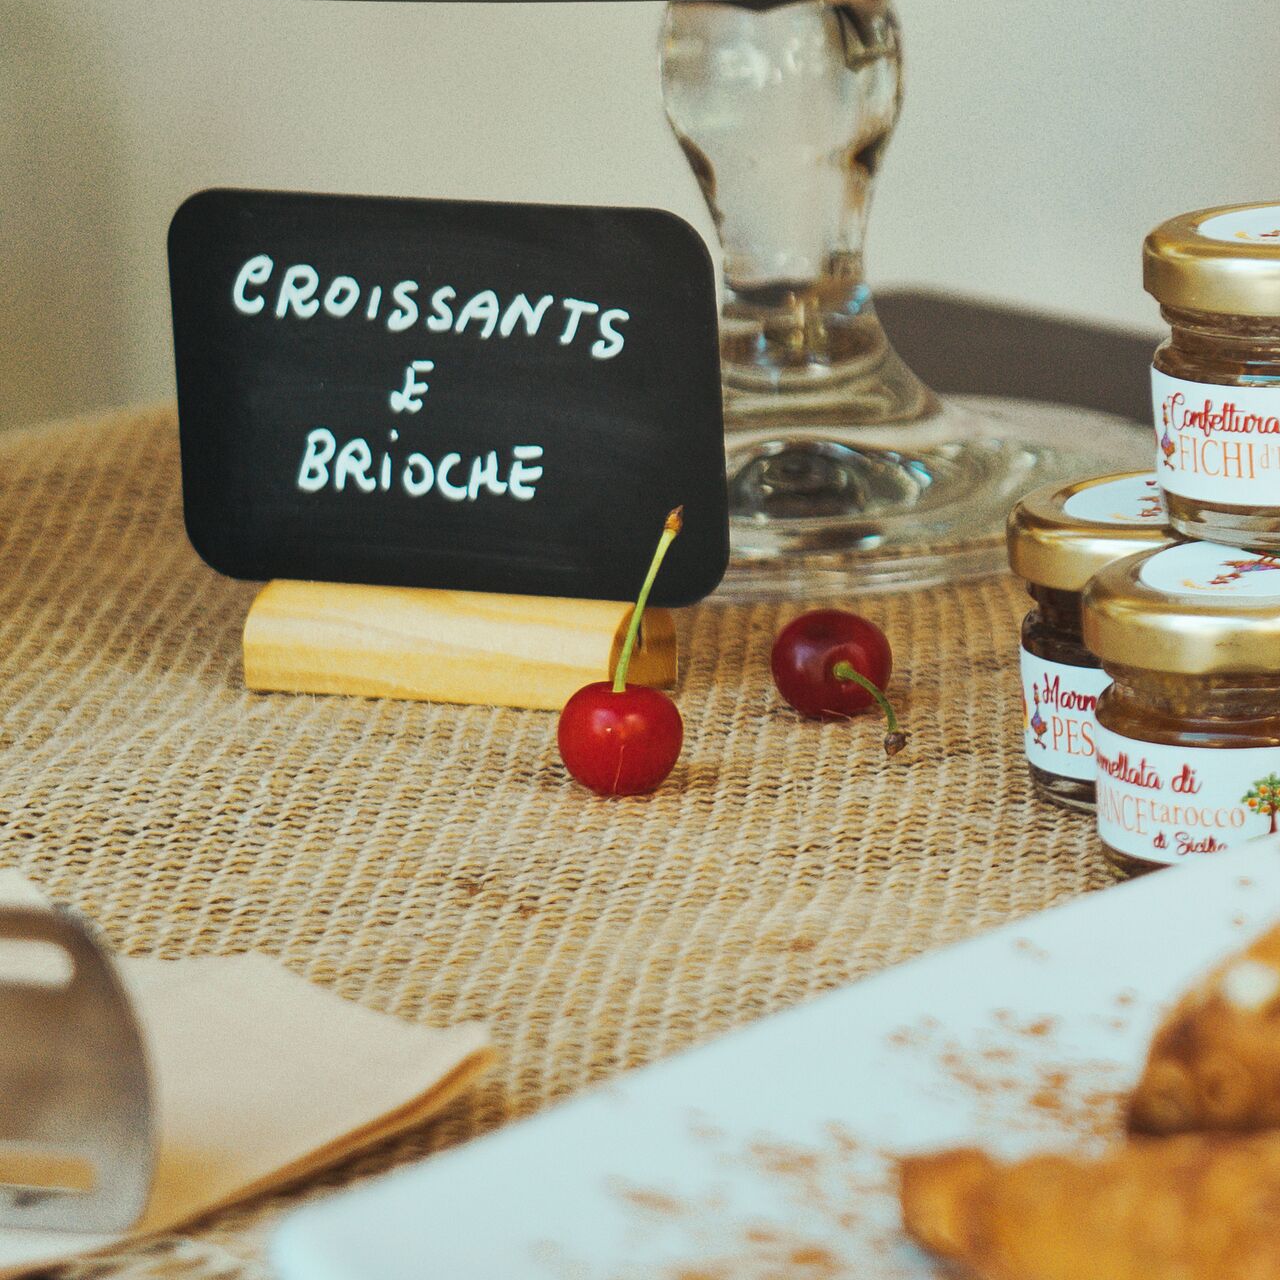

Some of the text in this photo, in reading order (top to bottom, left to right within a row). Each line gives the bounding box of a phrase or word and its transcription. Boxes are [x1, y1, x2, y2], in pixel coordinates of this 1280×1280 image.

[232, 254, 630, 359] CROISSANTS
[1179, 434, 1256, 479] FICHI
[1052, 716, 1095, 756] PES
[1171, 763, 1202, 794] di
[1151, 799, 1247, 828] tarocco
[1153, 831, 1169, 849] di
